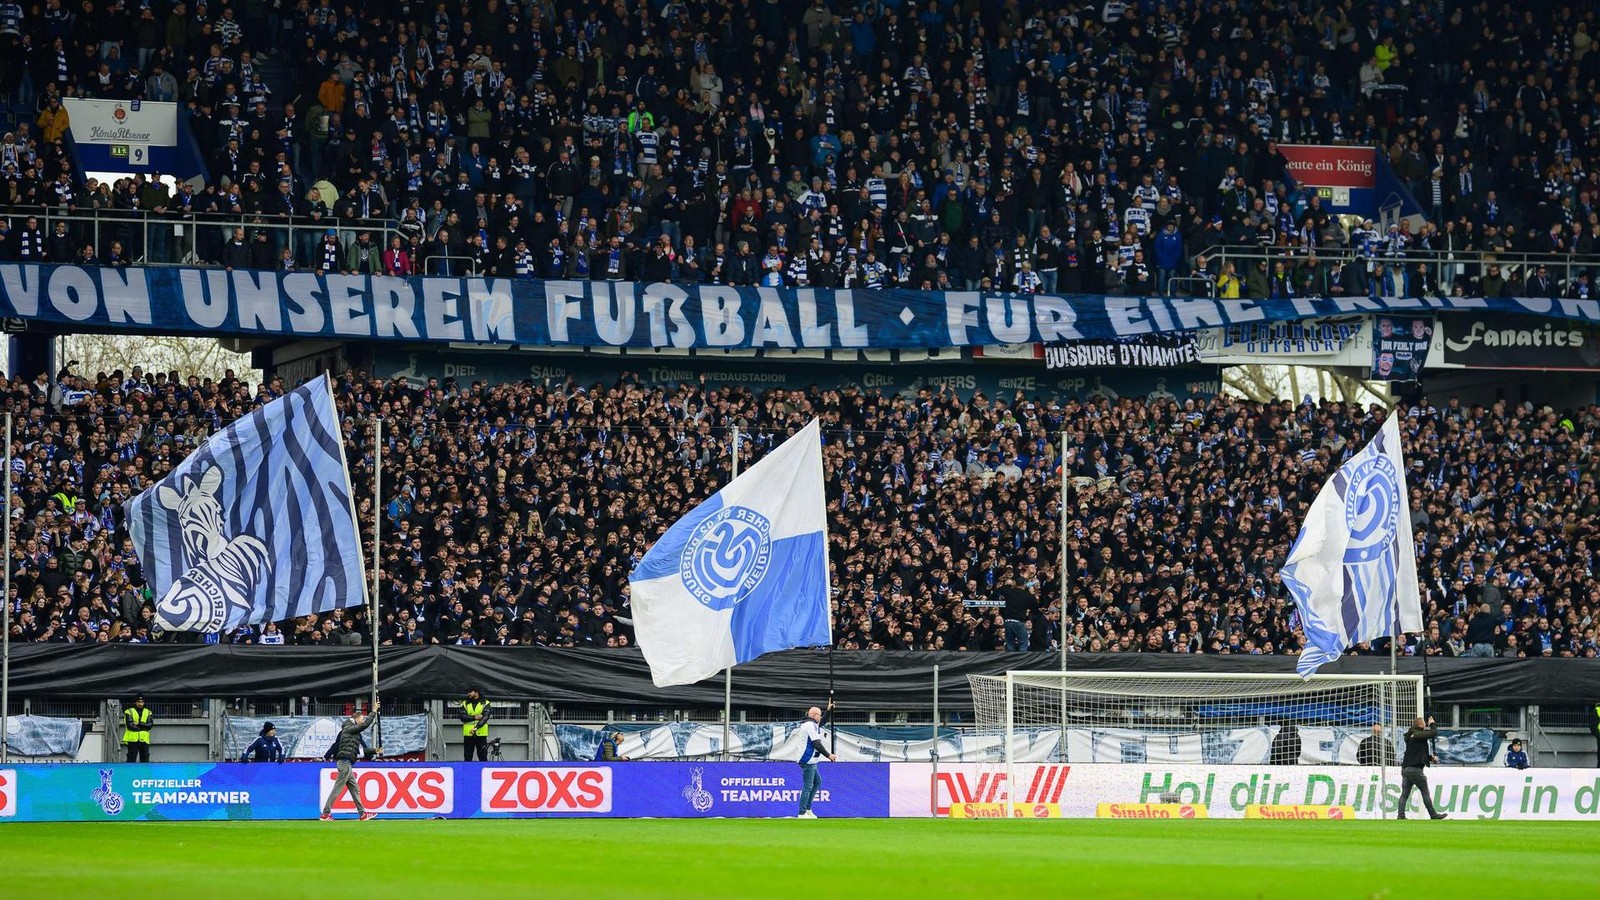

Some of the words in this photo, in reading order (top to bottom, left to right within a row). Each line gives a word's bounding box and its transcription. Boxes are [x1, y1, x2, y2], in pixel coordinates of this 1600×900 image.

[89, 126, 117, 140] König
[118, 128, 150, 140] Pilsener
[134, 149, 143, 161] 9
[1285, 157, 1312, 170] eute
[1316, 159, 1333, 171] ein
[1337, 159, 1372, 176] König
[0, 264, 152, 324] VON
[180, 269, 516, 341] UNSEREM
[945, 291, 1085, 346] FÜR
[1446, 321, 1585, 352] Fanatics
[1381, 340, 1392, 350] IHR
[1393, 341, 1413, 351] FEHLT
[1415, 341, 1428, 351] UNS
[1045, 343, 1116, 369] DUISBURG
[1120, 342, 1201, 367] DYNAMITES
[444, 363, 476, 378] DIETZ
[530, 364, 566, 379] SALOU
[648, 365, 694, 383] TÖNNIES
[704, 372, 786, 382] WEDAUSTADION
[863, 373, 894, 387] GRLIC
[928, 375, 976, 389] WOLTERS
[999, 377, 1035, 390] HEINZE
[1058, 378, 1085, 392] HOPP
[132, 779, 201, 788] OFFIZIELLER
[490, 770, 604, 809] ZOXS
[720, 778, 785, 787] OFFIZIELLER
[132, 791, 250, 804] TEAMPARTNER
[720, 790, 831, 802] TEAMPARTER
[1139, 772, 1216, 811] Hol
[1229, 773, 1290, 812] dir
[1520, 776, 1558, 814] in
[964, 803, 1024, 818] Sinalo
[1110, 803, 1170, 818] Sinalco
[1259, 804, 1319, 819] Sinalco
